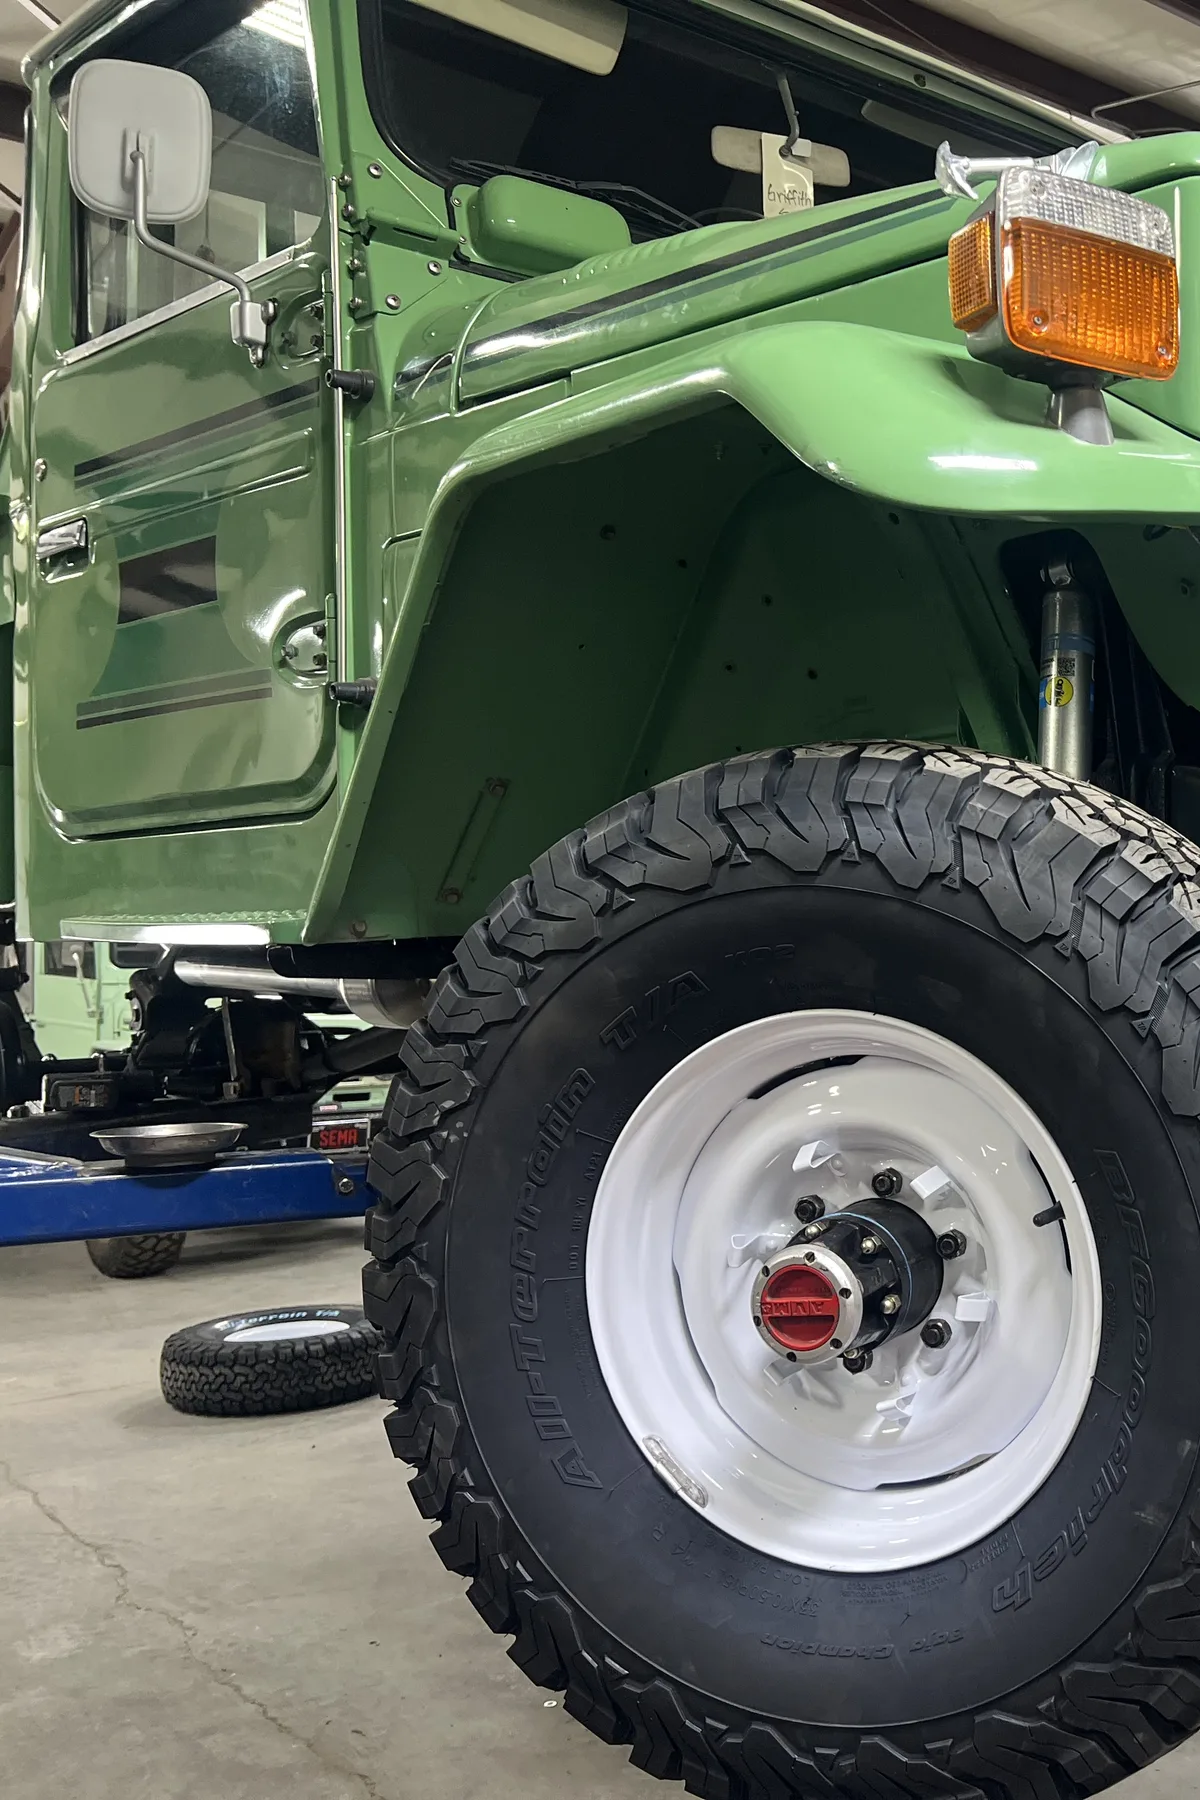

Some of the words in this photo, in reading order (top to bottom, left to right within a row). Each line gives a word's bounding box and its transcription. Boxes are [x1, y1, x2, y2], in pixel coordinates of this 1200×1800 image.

[767, 183, 812, 207] Griffith
[319, 1128, 358, 1148] SEMA
[509, 1066, 602, 1488] All-Terrain
[598, 969, 712, 1051] T/A
[774, 1568, 810, 1588] LOAD
[760, 1632, 894, 1660] Champion
